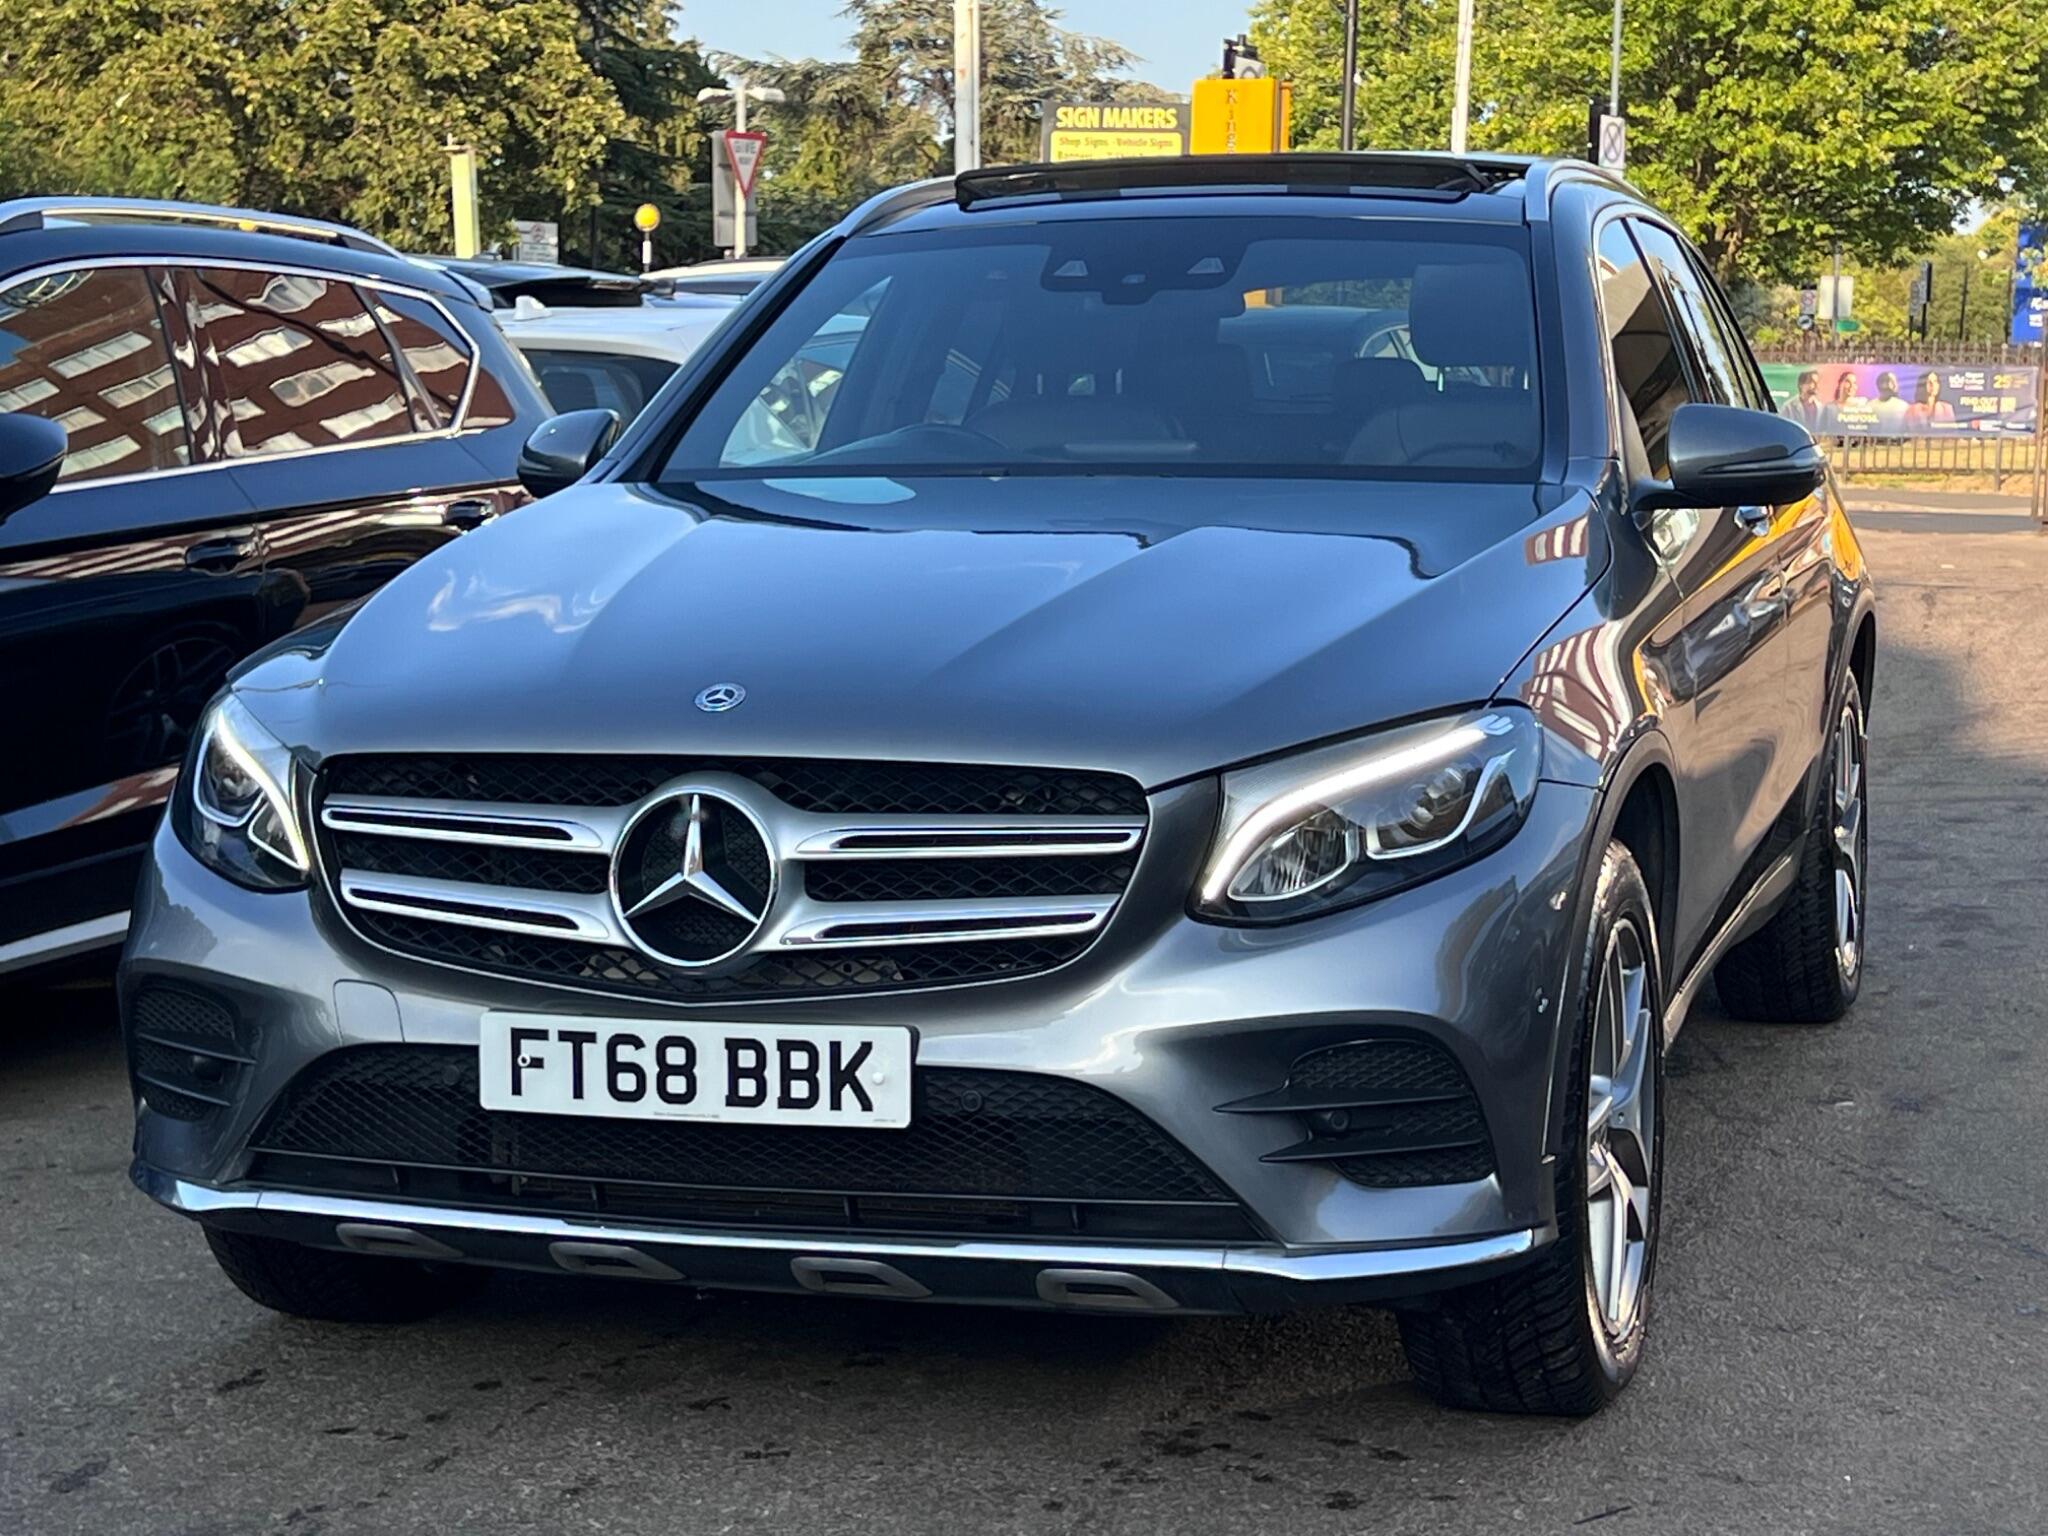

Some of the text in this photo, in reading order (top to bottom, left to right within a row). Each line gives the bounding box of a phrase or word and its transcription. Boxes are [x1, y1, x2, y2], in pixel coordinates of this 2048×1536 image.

[1056, 106, 1178, 129] SIGN MAKERS
[1084, 137, 1109, 149] Signs
[1149, 138, 1174, 149] Signs
[510, 1027, 874, 1112] FT68 BBK
